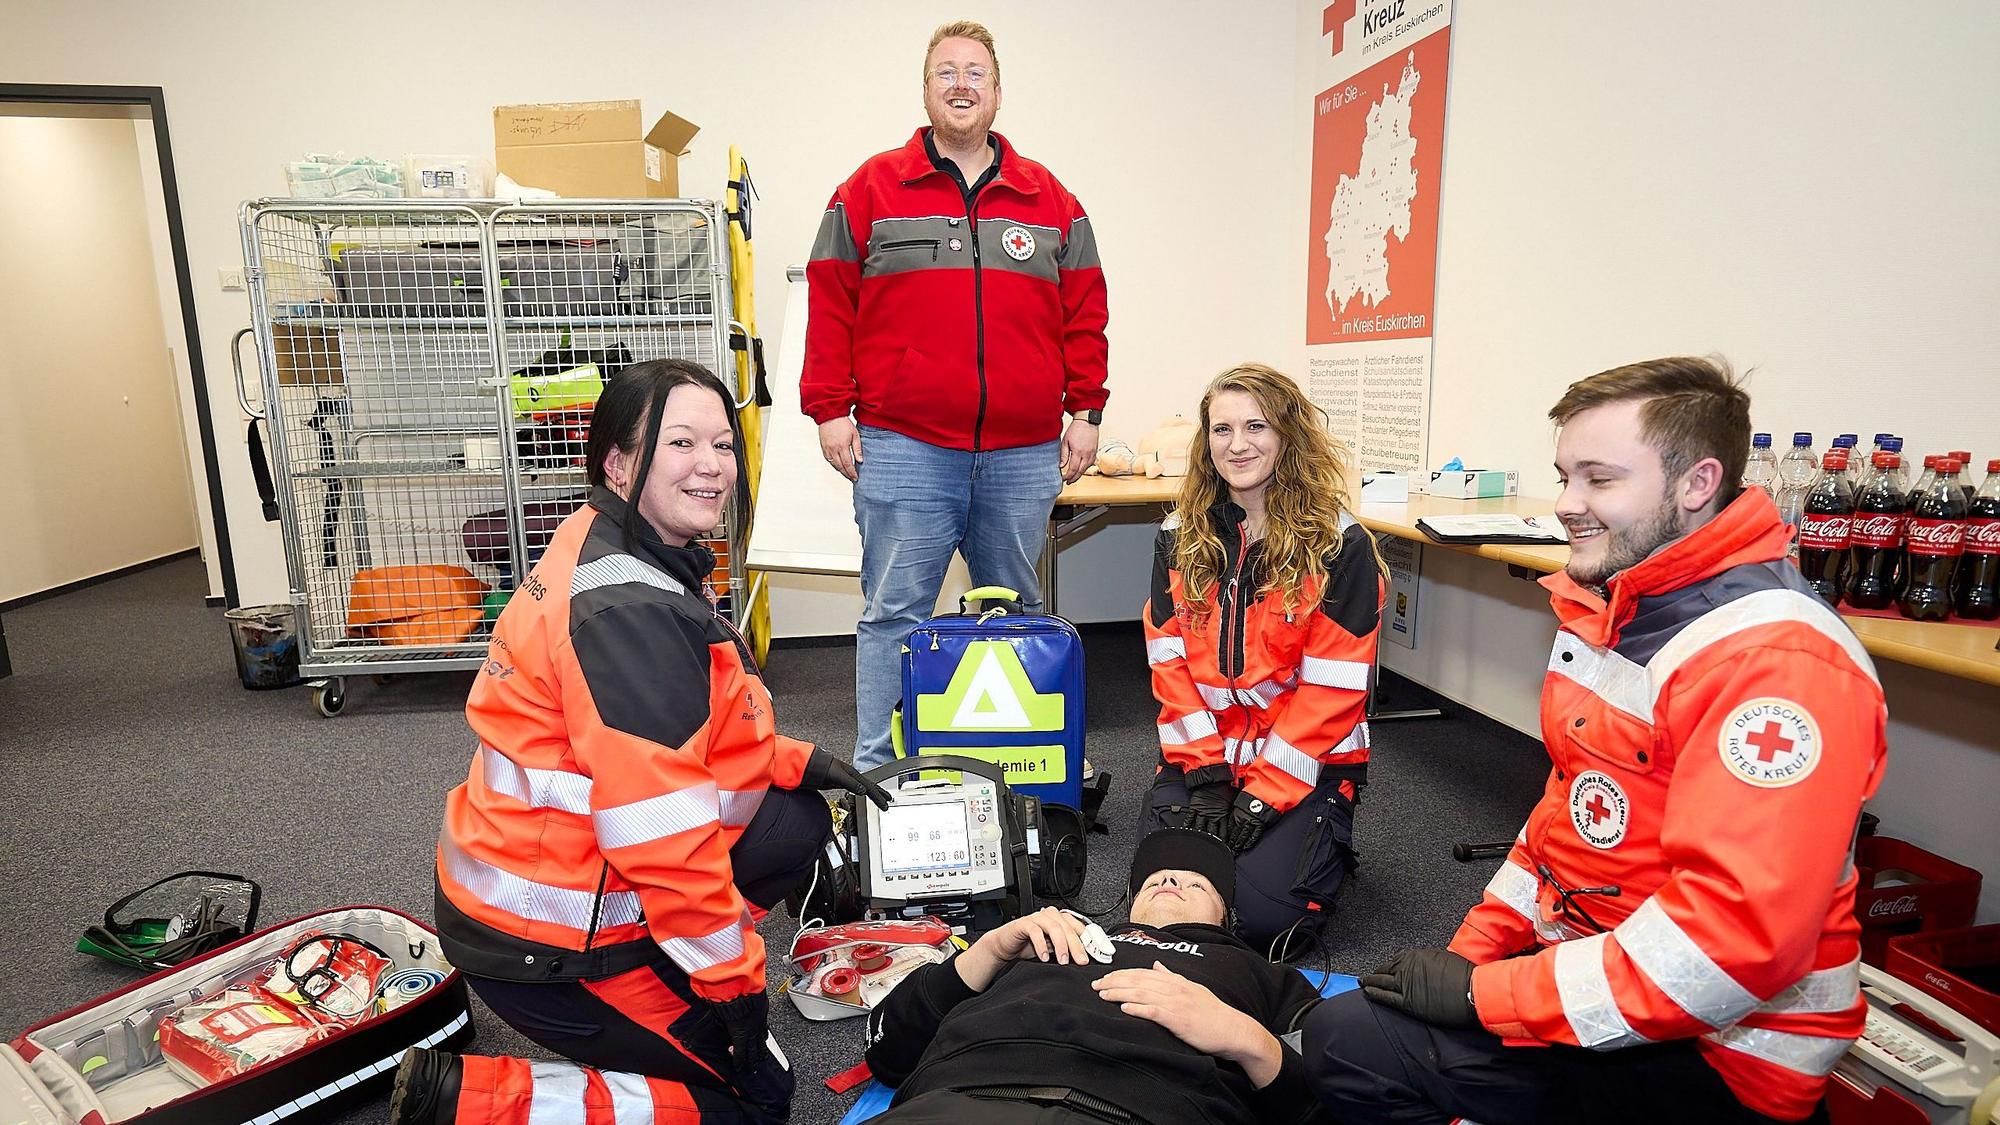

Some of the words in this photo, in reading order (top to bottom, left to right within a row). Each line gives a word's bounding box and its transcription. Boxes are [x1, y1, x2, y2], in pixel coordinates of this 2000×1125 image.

[1362, 42, 1371, 56] im
[1372, 30, 1393, 50] Kreis
[1395, 3, 1444, 38] Euskirchen
[1363, 0, 1405, 39] Kreuz
[1319, 97, 1331, 116] Wir
[1332, 93, 1344, 110] für
[1344, 85, 1358, 104] Sie
[1342, 320, 1352, 334] im
[1353, 317, 1374, 334] Kreis
[1375, 312, 1426, 332] Euskirchen
[1309, 368, 1358, 377] Suchdienst
[1363, 376, 1423, 387] Katastrophenschutz
[1362, 413, 1421, 426] Besuchshundedienst
[1361, 445, 1420, 464] Schulbetreuung
[1398, 439, 1420, 451] Dienst
[1506, 473, 1516, 481] 100
[1801, 515, 1852, 538] Coca-Cola
[1908, 520, 1966, 543] Coca-Cola
[1735, 705, 1812, 742] DEUTSCHES
[1041, 758, 1047, 772] 1
[1729, 738, 1757, 776] ROTES
[1764, 752, 1809, 779] KREUZ
[1572, 776, 1597, 807] Deutsches
[1597, 776, 1619, 798] Rotes
[1617, 797, 1626, 827] Kreuz
[907, 832, 919, 842] 99
[1574, 811, 1622, 845] Rettungsdienst
[929, 851, 946, 862] 123
[953, 850, 965, 861] 60
